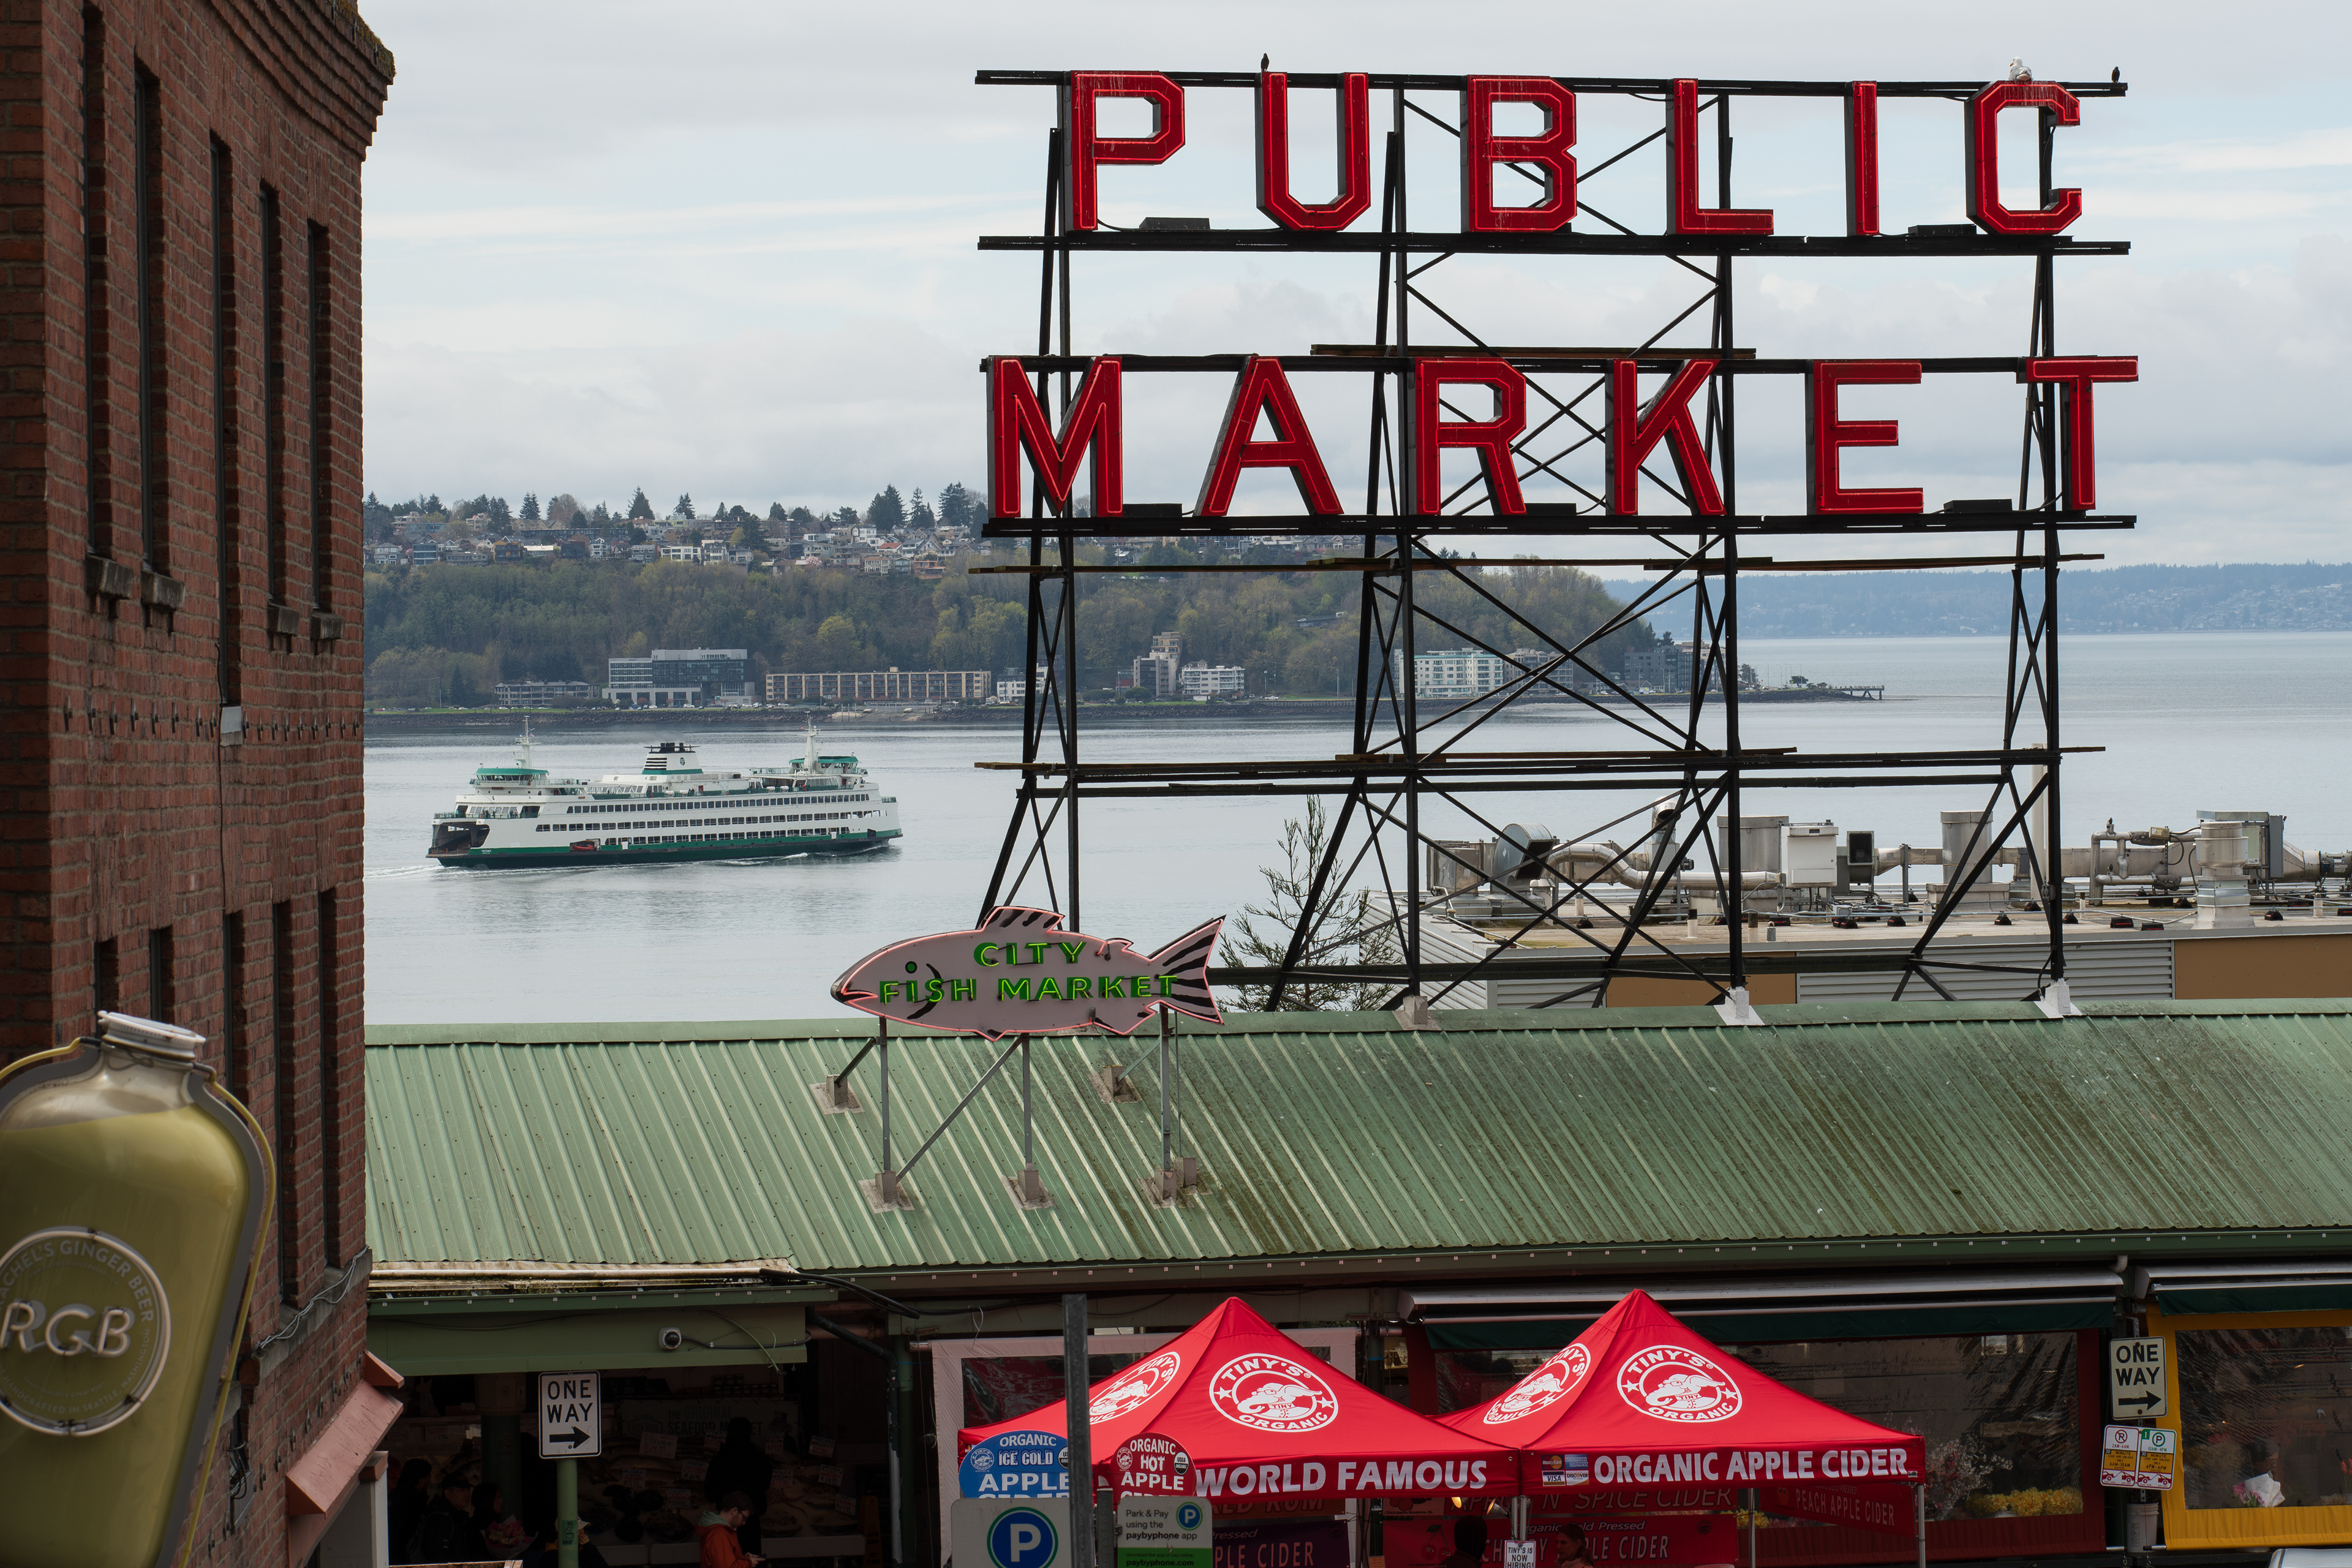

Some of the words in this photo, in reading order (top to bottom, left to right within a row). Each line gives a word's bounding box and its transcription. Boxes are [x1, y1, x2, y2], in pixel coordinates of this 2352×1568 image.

[1065, 71, 2082, 236] PUBLIC
[989, 355, 2139, 518] MARKET
[973, 941, 1087, 967] CITY
[879, 978, 977, 1005] FISH
[997, 975, 1180, 1002] MARKET
[59, 1240, 132, 1278] GINGER
[127, 1275, 154, 1323] BEER
[0, 1300, 135, 1358] RGB
[1627, 1349, 1706, 1374] TINY'S
[2116, 1344, 2158, 1363] ONE
[2, 1376, 66, 1414] HANDCRAFTED
[121, 1328, 151, 1389] WASHINGTON
[1221, 1358, 1303, 1381] TINY'S
[2116, 1366, 2160, 1386] WAY
[548, 1379, 592, 1400] ONE
[547, 1403, 593, 1423] WAY
[668, 1411, 681, 1420] THE
[1238, 1411, 1328, 1430] ORGANIC
[1648, 1402, 1733, 1420] ORGANIC
[668, 1422, 715, 1434] SEAFOOD
[720, 1422, 763, 1436] MET
[999, 1434, 1057, 1447] ORGANIC
[1129, 1438, 1176, 1455] ORGANIC
[998, 1450, 1019, 1466] ICE
[1022, 1450, 1054, 1465] COLD
[1140, 1453, 1165, 1472] HOT
[1594, 1452, 1718, 1483] ORGANIC
[1725, 1450, 1815, 1481] APPLE
[1821, 1447, 1909, 1477] CIDER
[978, 1472, 1069, 1492] APPLE
[1120, 1471, 1184, 1491] APPLE
[1196, 1462, 1326, 1497] WORLD
[1336, 1460, 1487, 1490] FAMOUS
[1574, 1491, 1648, 1509] SPICE
[1656, 1488, 1732, 1508] CIDER
[1840, 1484, 1857, 1495] PRESSED
[1154, 1510, 1169, 1519] Pay
[1795, 1488, 1826, 1515] PEACH
[1830, 1494, 1861, 1521] APPLE
[1865, 1500, 1895, 1527] CIDER
[1126, 1521, 1147, 1529] using
[1598, 1520, 1646, 1531] Pressed
[1126, 1531, 1179, 1540] paybyphone
[1215, 1544, 1246, 1568] PLE
[1257, 1541, 1314, 1568] CIDER
[1482, 1538, 1549, 1564] CHY
[1618, 1534, 1669, 1561] CIDER
[1126, 1559, 1194, 1567] paybyphone.com
